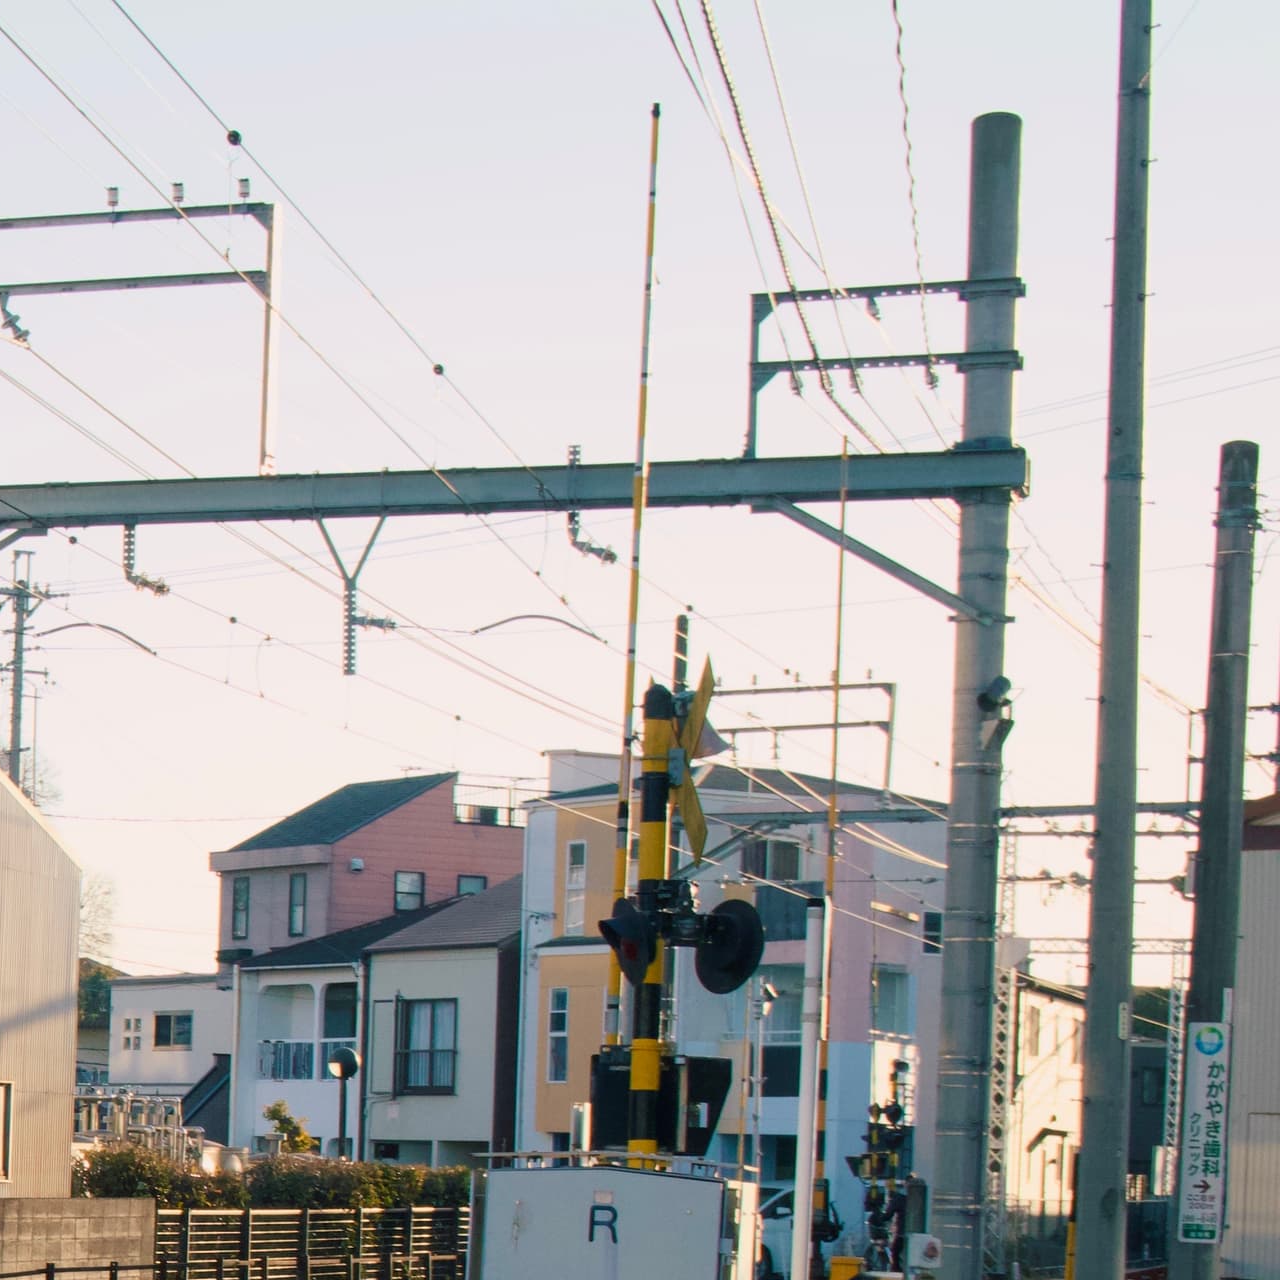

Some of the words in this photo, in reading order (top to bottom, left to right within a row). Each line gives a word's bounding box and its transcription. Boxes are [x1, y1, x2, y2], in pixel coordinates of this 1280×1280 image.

[1187, 1112, 1201, 1177] クリニック
[1201, 1061, 1225, 1178] かがやき歯科
[589, 1205, 618, 1244] R
